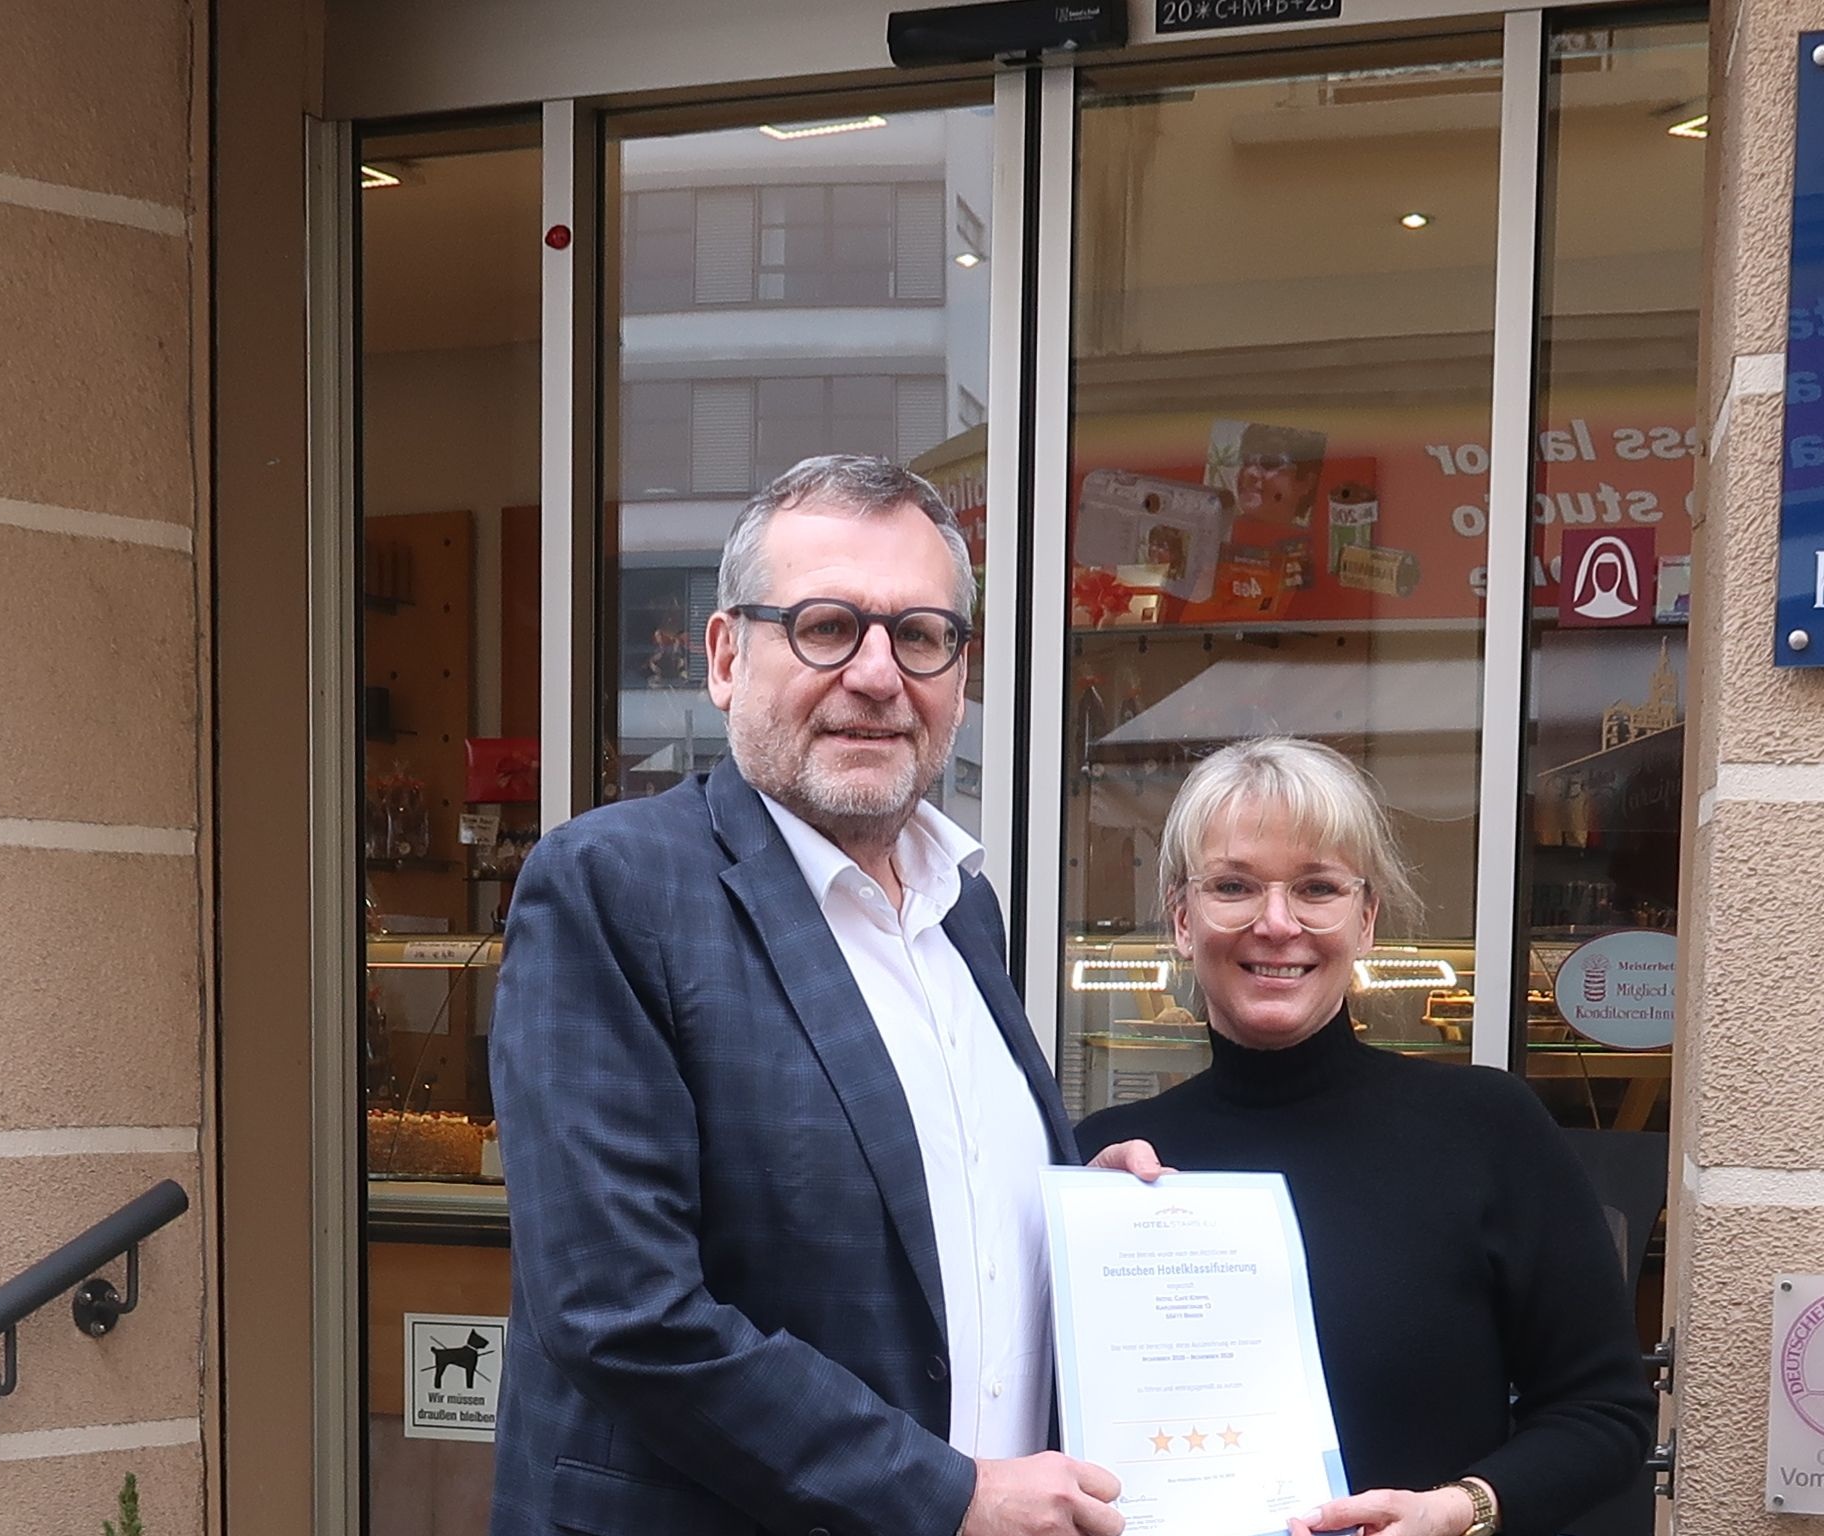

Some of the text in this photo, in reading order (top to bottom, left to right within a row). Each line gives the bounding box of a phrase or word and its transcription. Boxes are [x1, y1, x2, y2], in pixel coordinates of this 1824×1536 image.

[1617, 983, 1666, 1001] Mitglied
[1103, 1262, 1257, 1277] Deutschen Hotelklassifizierung
[428, 1392, 485, 1405] Wir müssen
[417, 1408, 495, 1422] draußen bleiben
